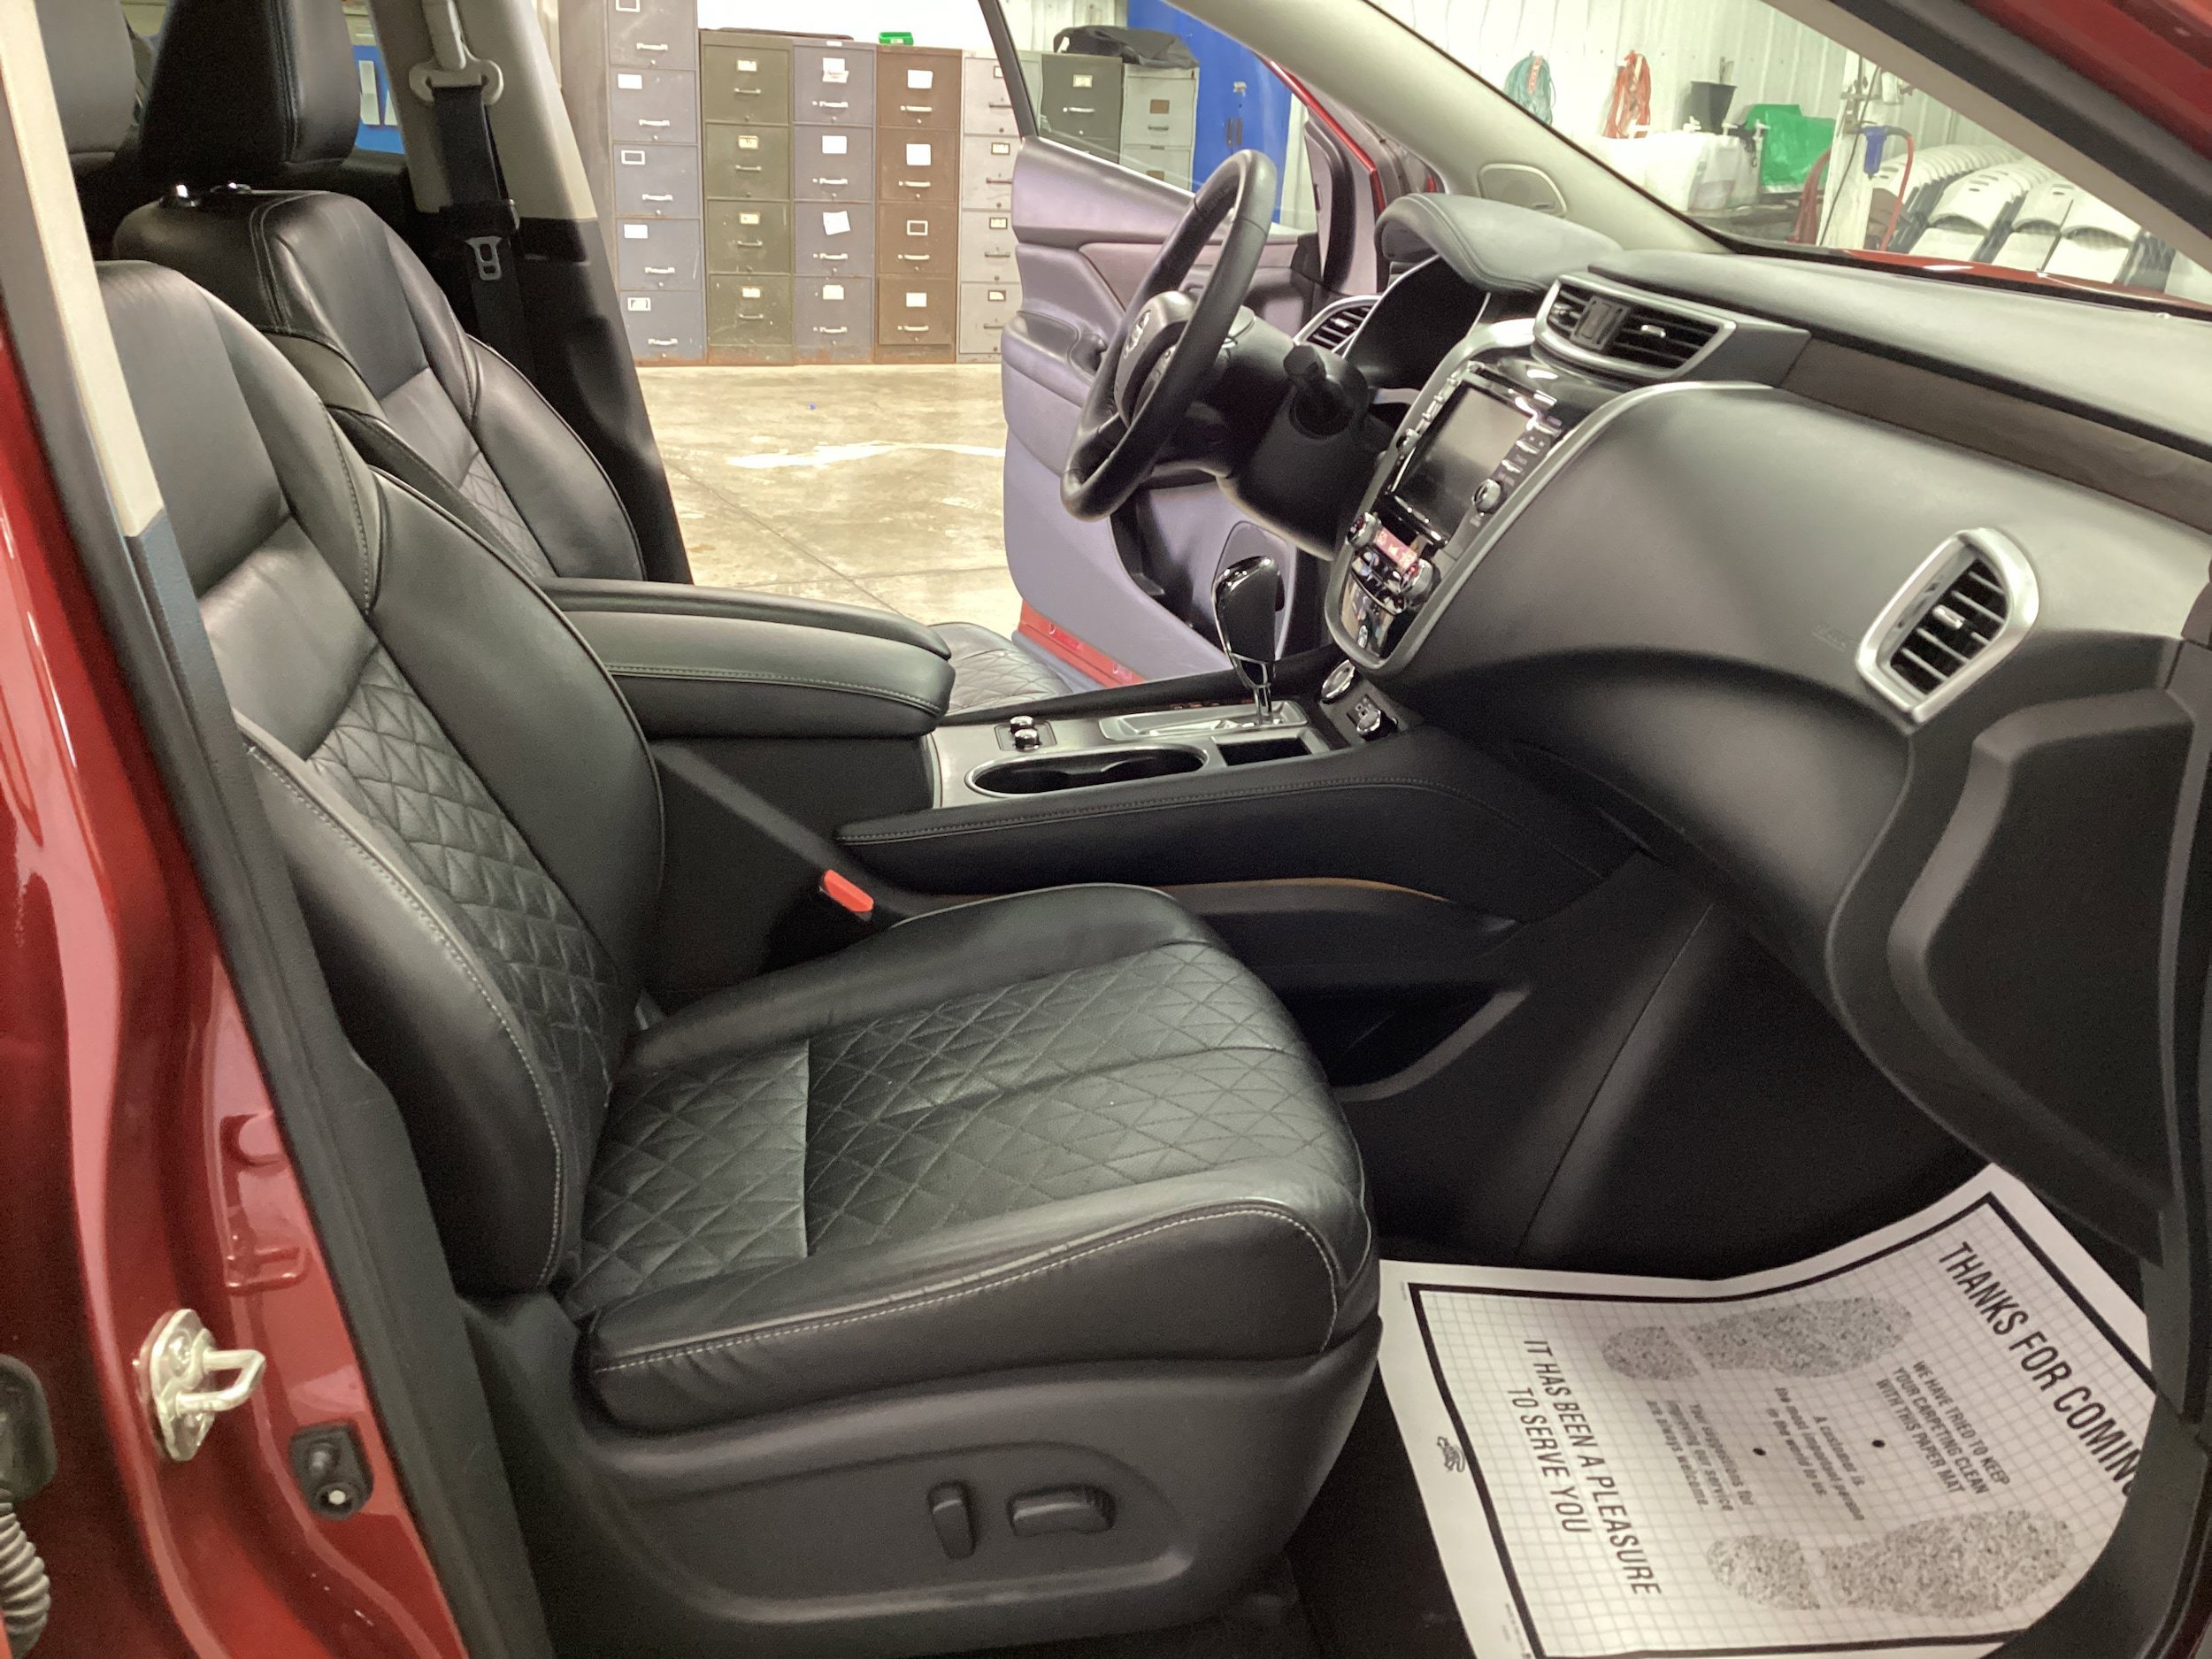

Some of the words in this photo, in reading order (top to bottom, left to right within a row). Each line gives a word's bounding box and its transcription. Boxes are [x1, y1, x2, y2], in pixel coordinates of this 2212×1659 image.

[1524, 1340, 1553, 1356] IT
[1939, 1240, 2029, 1335] THANKS
[2008, 1331, 2072, 1391] FOR
[2053, 1386, 2141, 1495] COMIN
[1508, 1387, 1539, 1408] TO
[1533, 1363, 1571, 1396] HAS
[1553, 1402, 1598, 1447] BEEN
[1773, 1420, 1791, 1436] the
[1786, 1440, 1813, 1466] world
[1876, 1379, 1904, 1407] WITH
[1895, 1406, 1922, 1431] THIS
[1912, 1432, 1946, 1469] PAPER
[1937, 1469, 1965, 1494] MAT
[1893, 1366, 1921, 1397] YOUR
[1912, 1396, 1962, 1456] CARPETING
[1955, 1456, 1989, 1494] CLEAN
[1913, 1360, 1933, 1379] WE
[1924, 1379, 1954, 1407] HAVE
[1946, 1405, 1977, 1439] TRIED
[1968, 1439, 1988, 1455] TO
[1980, 1456, 2010, 1485] KEEP
[1520, 1415, 1570, 1477] SERVE
[1577, 1455, 1606, 1468] A
[1774, 1387, 1791, 1402] the
[1786, 1405, 1810, 1430] most
[1801, 1432, 1842, 1482] important
[1832, 1485, 1865, 1521] person
[1820, 1426, 1857, 1471] customer
[1550, 1486, 1592, 1532] YOU
[1704, 1470, 1733, 1510] service
[1586, 1477, 1662, 1594] PLEASURE
